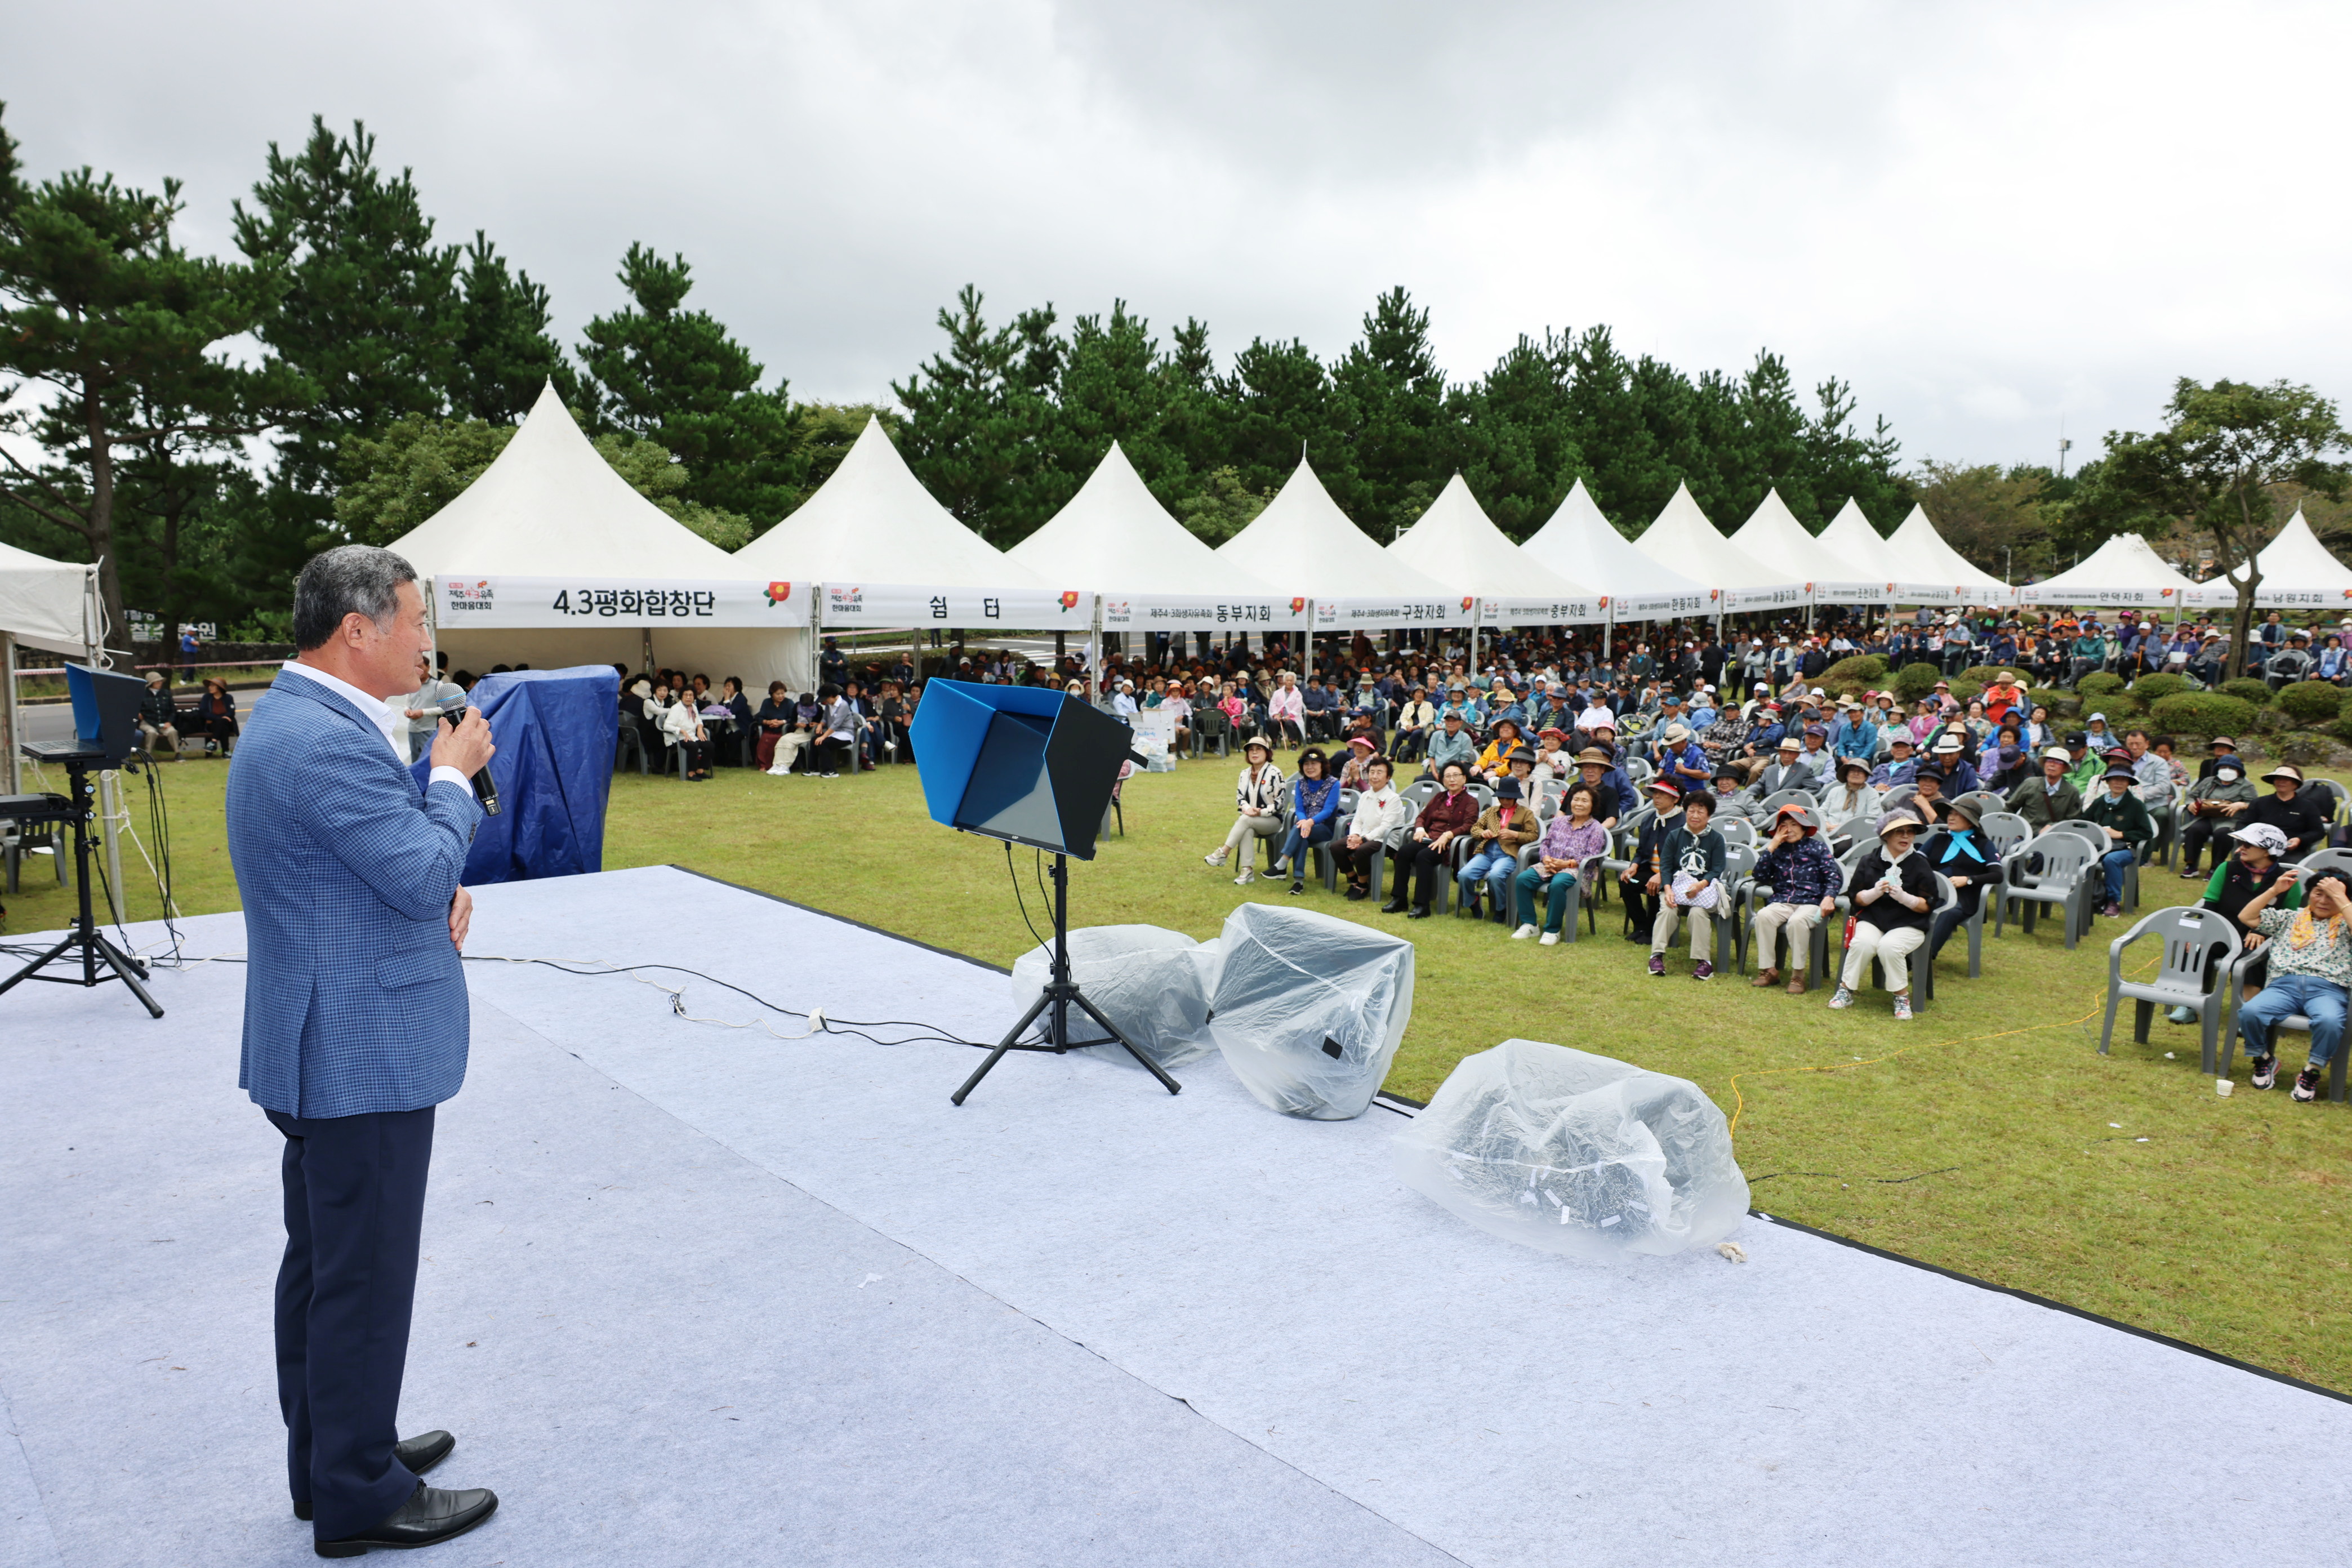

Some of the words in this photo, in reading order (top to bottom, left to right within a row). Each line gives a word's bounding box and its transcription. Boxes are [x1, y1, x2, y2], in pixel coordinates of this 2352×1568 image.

[451, 601, 491, 610] 한마음대회
[553, 589, 715, 617] 4.3평화합창단
[1672, 597, 1700, 611] 한림지회
[2273, 594, 2323, 603] 남원지회
[1217, 605, 1270, 622] 동부지회
[1402, 604, 1445, 620] 구좌지회
[1551, 604, 1587, 618] 중부지회
